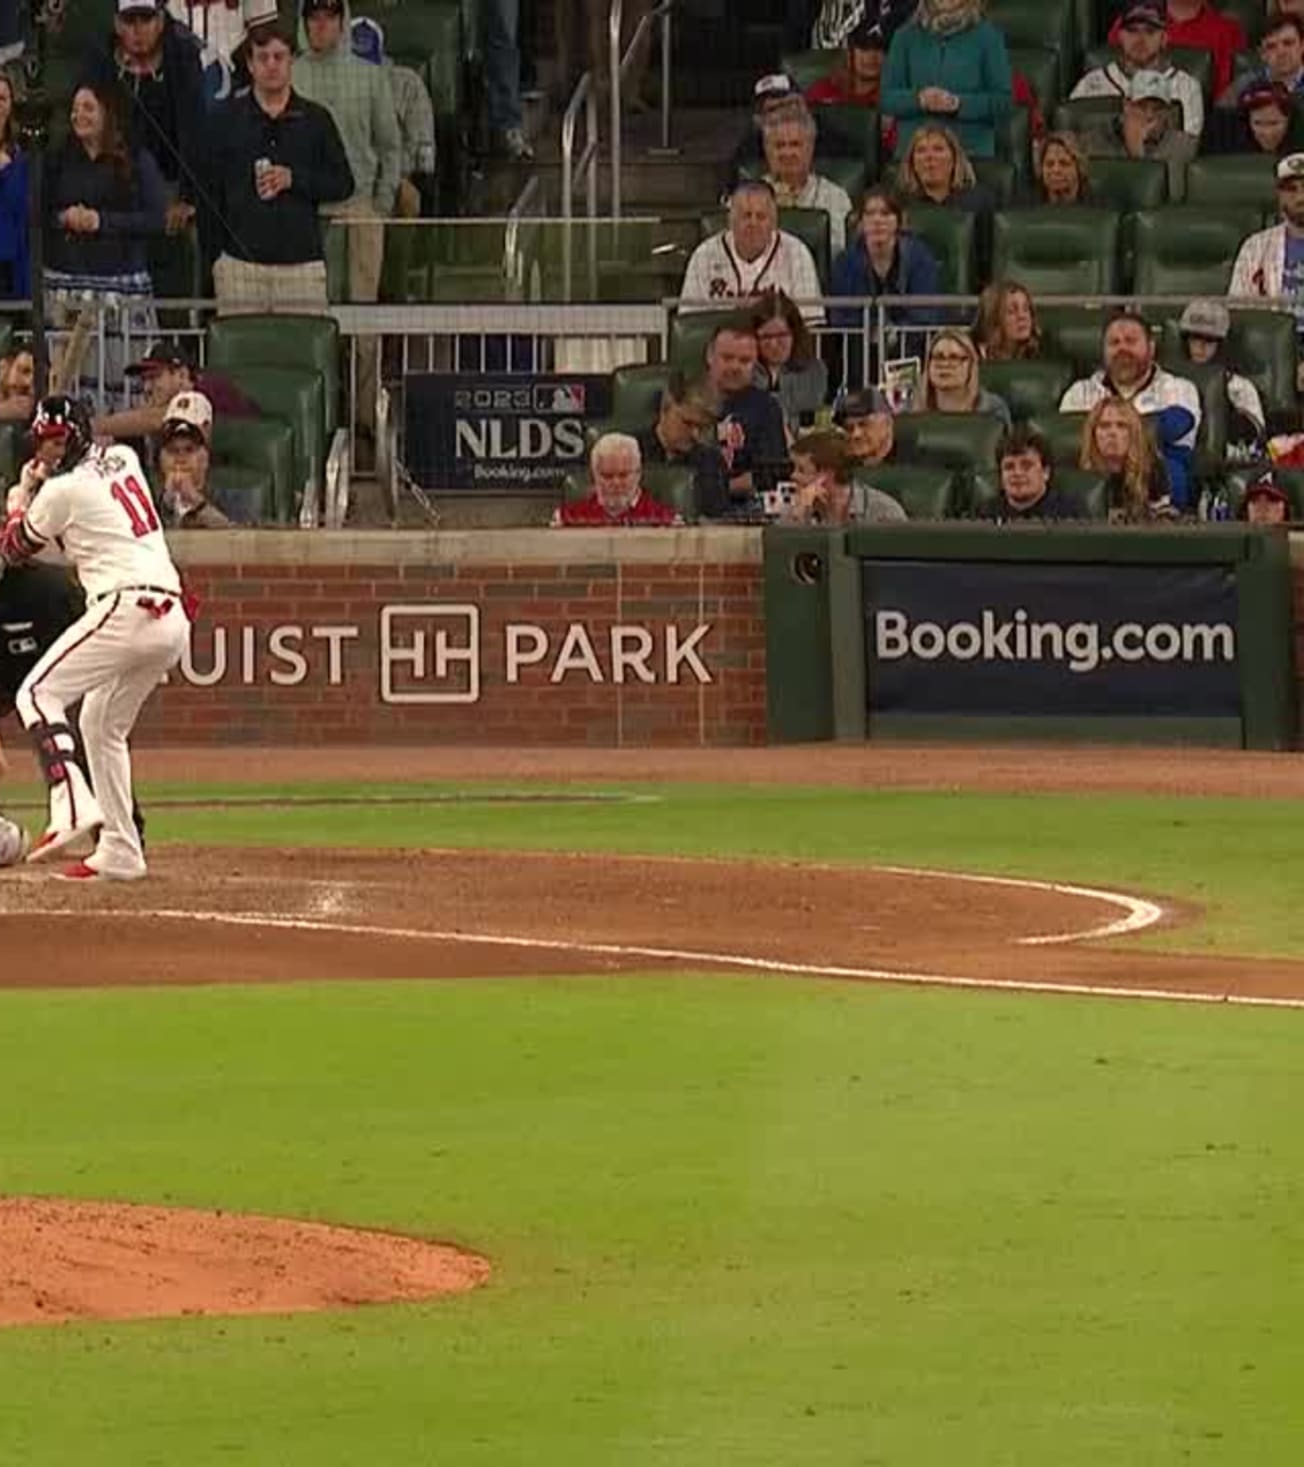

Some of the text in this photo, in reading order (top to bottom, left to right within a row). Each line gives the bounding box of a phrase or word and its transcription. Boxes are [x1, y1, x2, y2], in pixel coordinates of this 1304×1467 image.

[455, 418, 585, 459] NLDS
[110, 474, 160, 539] 11
[160, 625, 359, 685] UIST
[505, 622, 714, 685] PARK
[875, 608, 1234, 673] Booking.com
